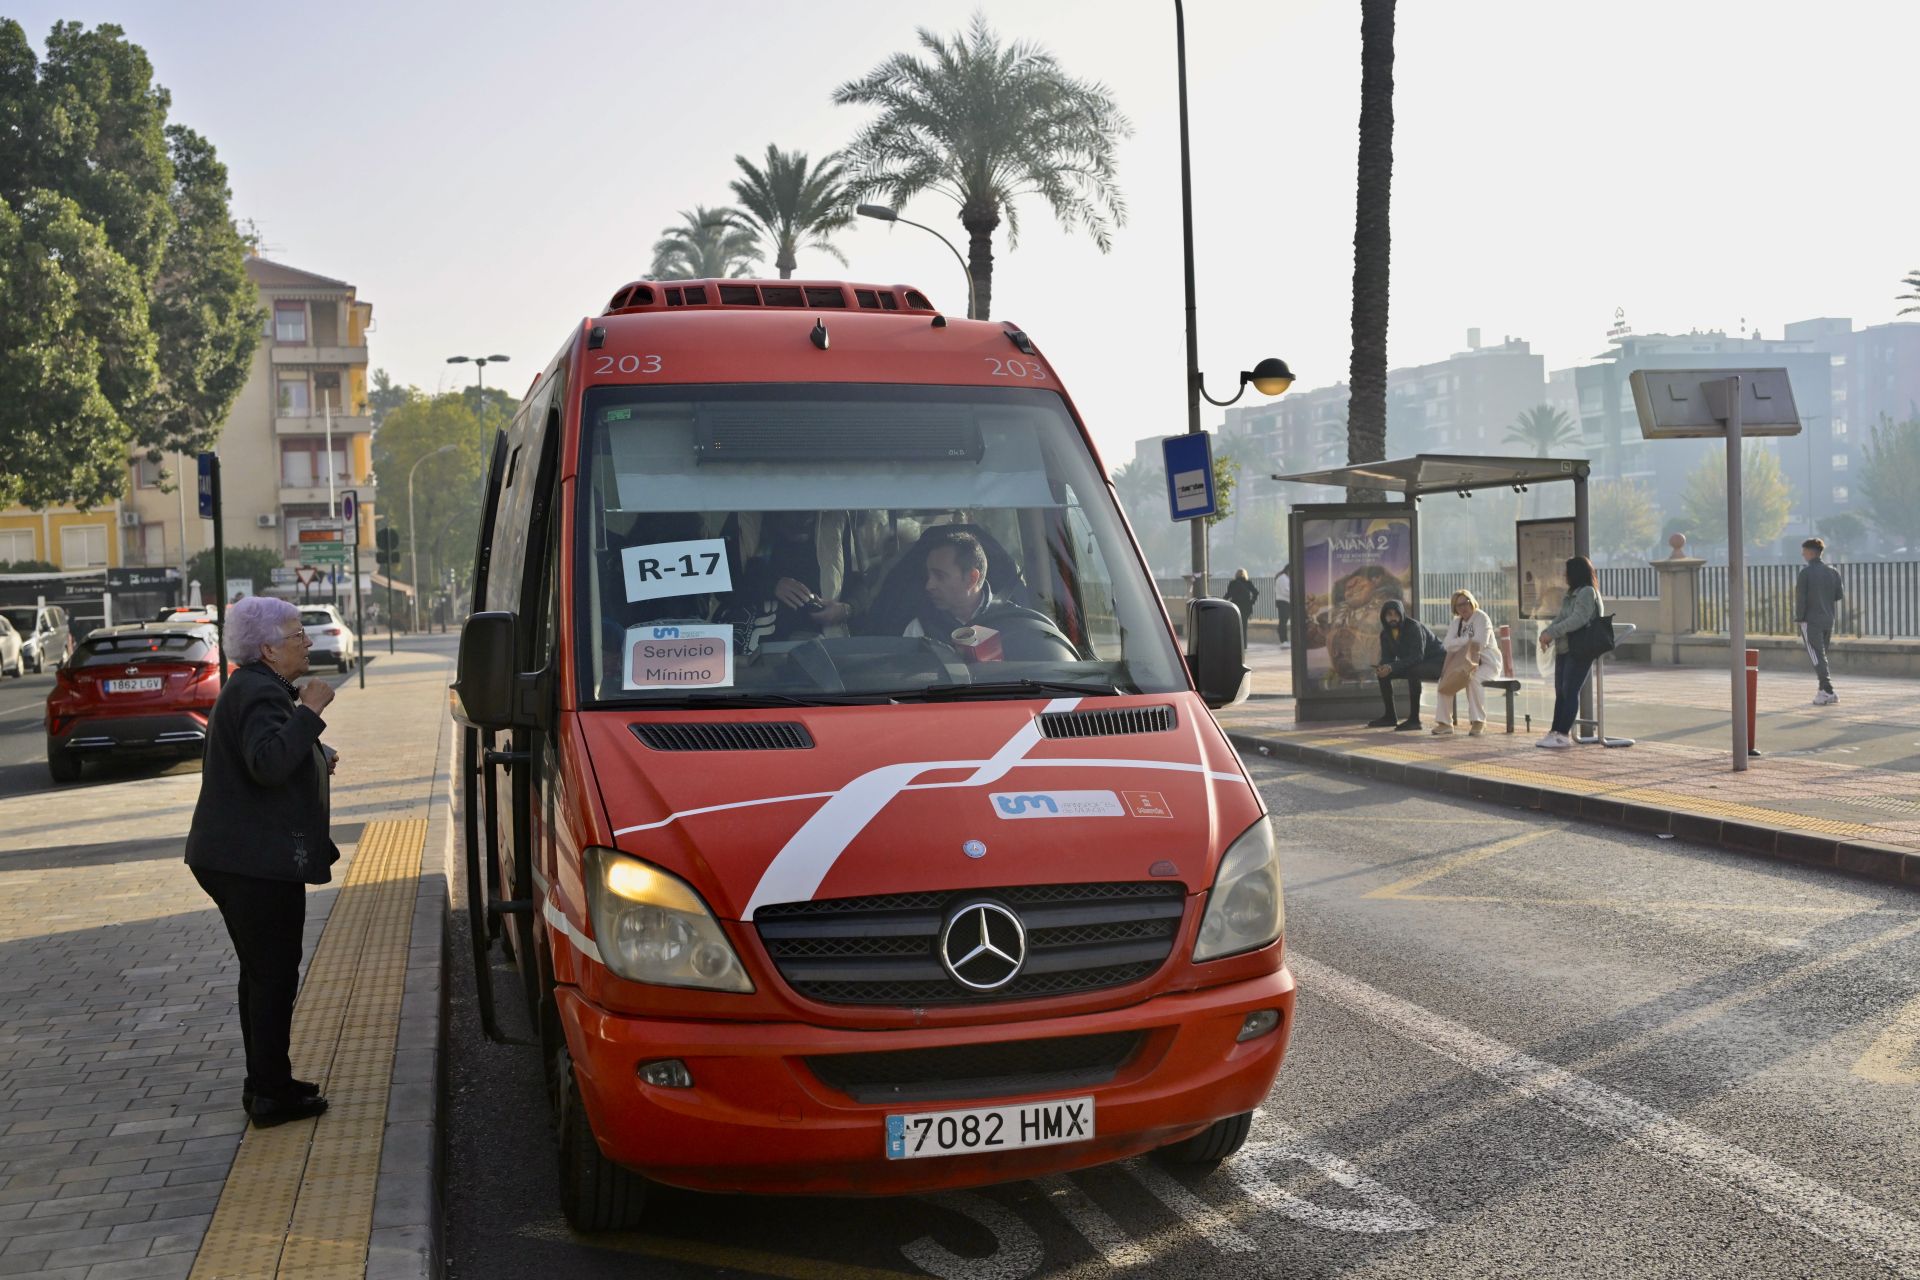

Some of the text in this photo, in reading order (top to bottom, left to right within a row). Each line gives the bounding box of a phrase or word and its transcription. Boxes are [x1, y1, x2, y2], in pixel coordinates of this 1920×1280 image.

[594, 354, 662, 374] 203
[984, 357, 1047, 380] 203
[1377, 535, 1389, 551] 2
[638, 552, 721, 583] R-17
[643, 643, 715, 659] Servicio
[646, 668, 712, 682] Mínimo
[112, 679, 159, 690] 1862 LGV
[913, 1103, 1085, 1152] 7082 HMX
[892, 1141, 901, 1151] E
